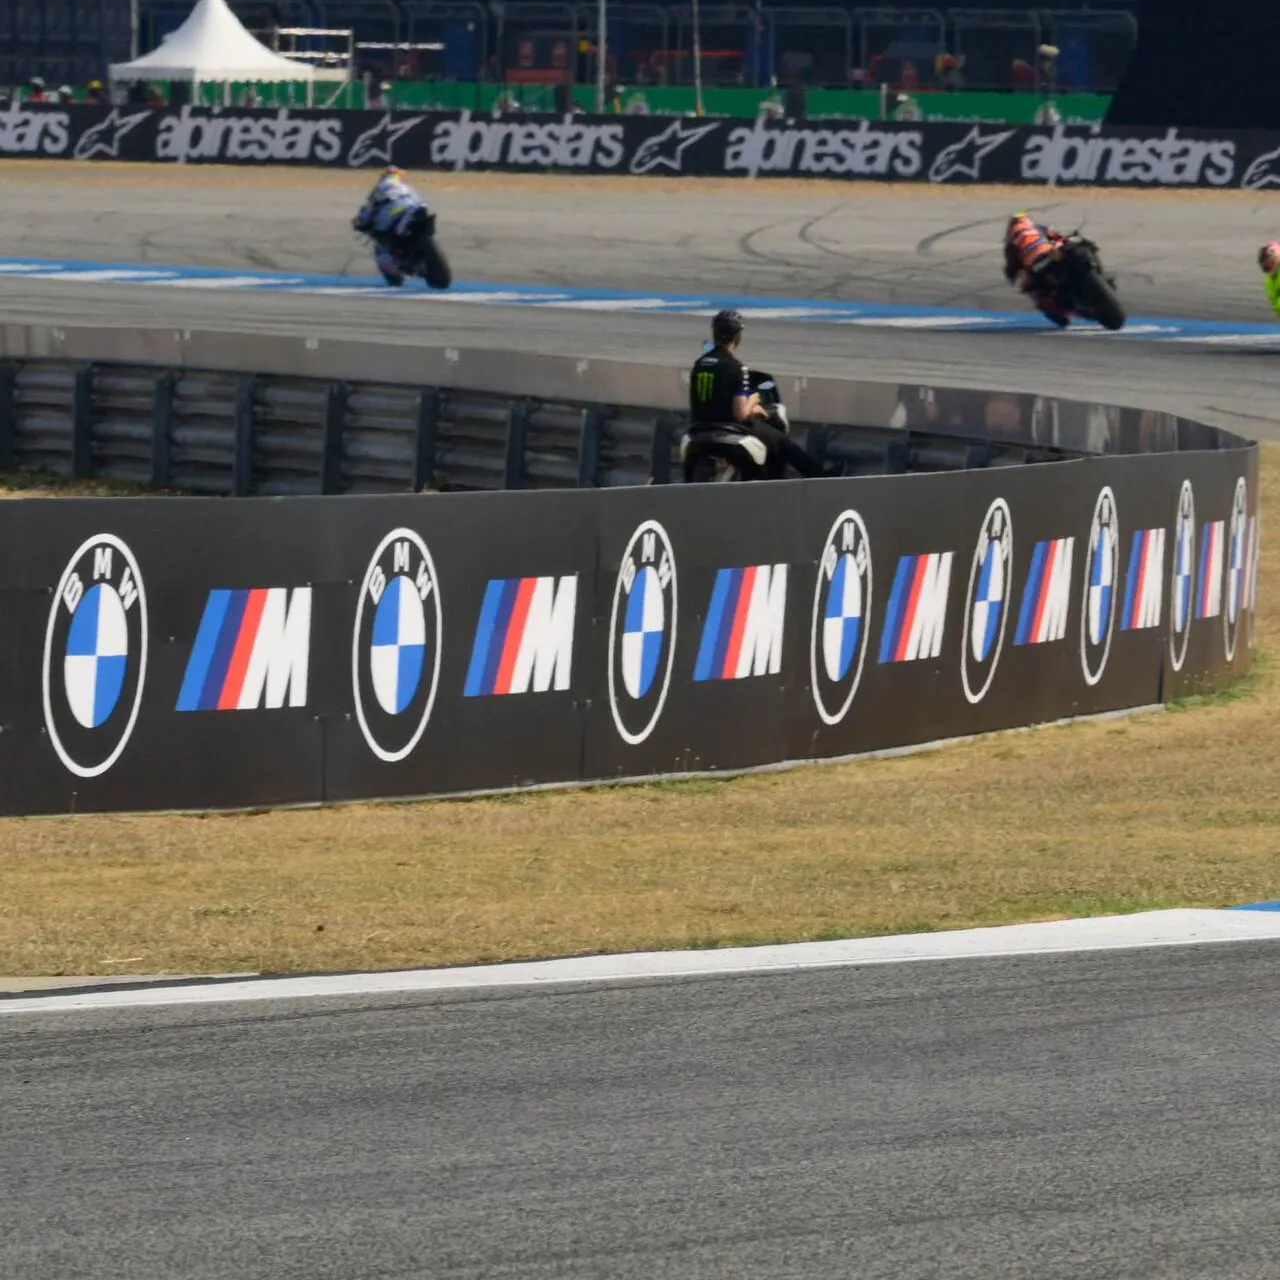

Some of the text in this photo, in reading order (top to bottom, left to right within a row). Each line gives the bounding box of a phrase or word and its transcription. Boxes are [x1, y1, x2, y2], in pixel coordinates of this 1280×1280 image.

[155, 104, 343, 165] alpinestars
[429, 109, 625, 172] alpinestars
[723, 116, 923, 178] alpinestars
[1020, 120, 1236, 185] alpinestars
[236, 586, 312, 710] M
[507, 575, 577, 695] M
[734, 563, 788, 680] M
[903, 551, 953, 663] M
